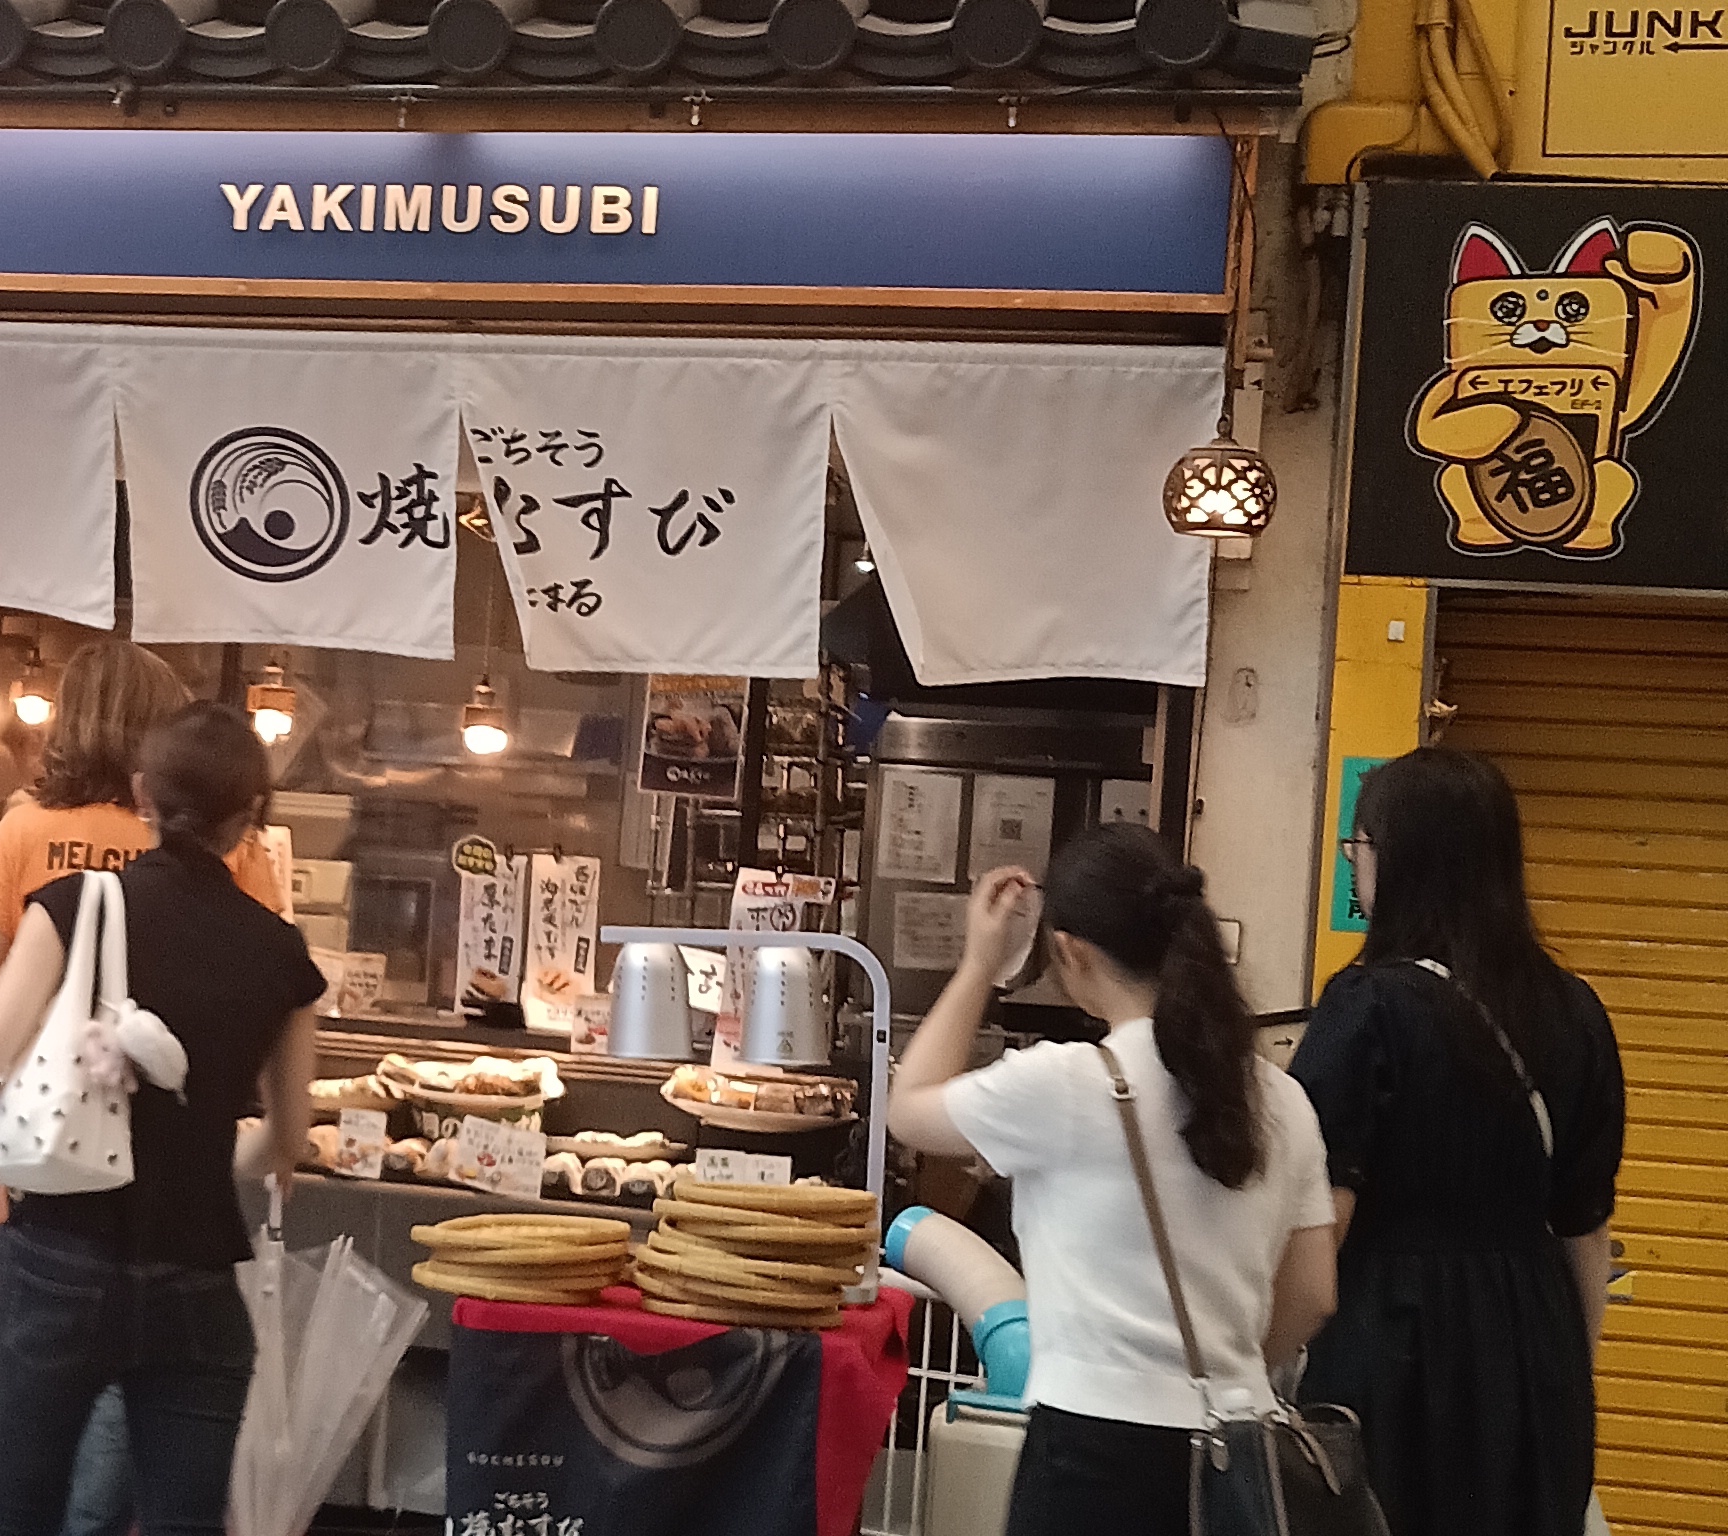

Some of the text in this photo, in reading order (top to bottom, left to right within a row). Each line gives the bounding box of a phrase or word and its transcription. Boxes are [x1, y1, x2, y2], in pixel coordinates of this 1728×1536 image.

[1563, 10, 1726, 39] JUNK
[1569, 41, 1656, 56] ジャンクル
[219, 182, 660, 235] YAKIMUSUBI
[1497, 377, 1584, 398] エフェフリ
[470, 426, 604, 467] ごちそう
[1490, 438, 1576, 515] 福
[493, 1490, 547, 1510] ごちそう
